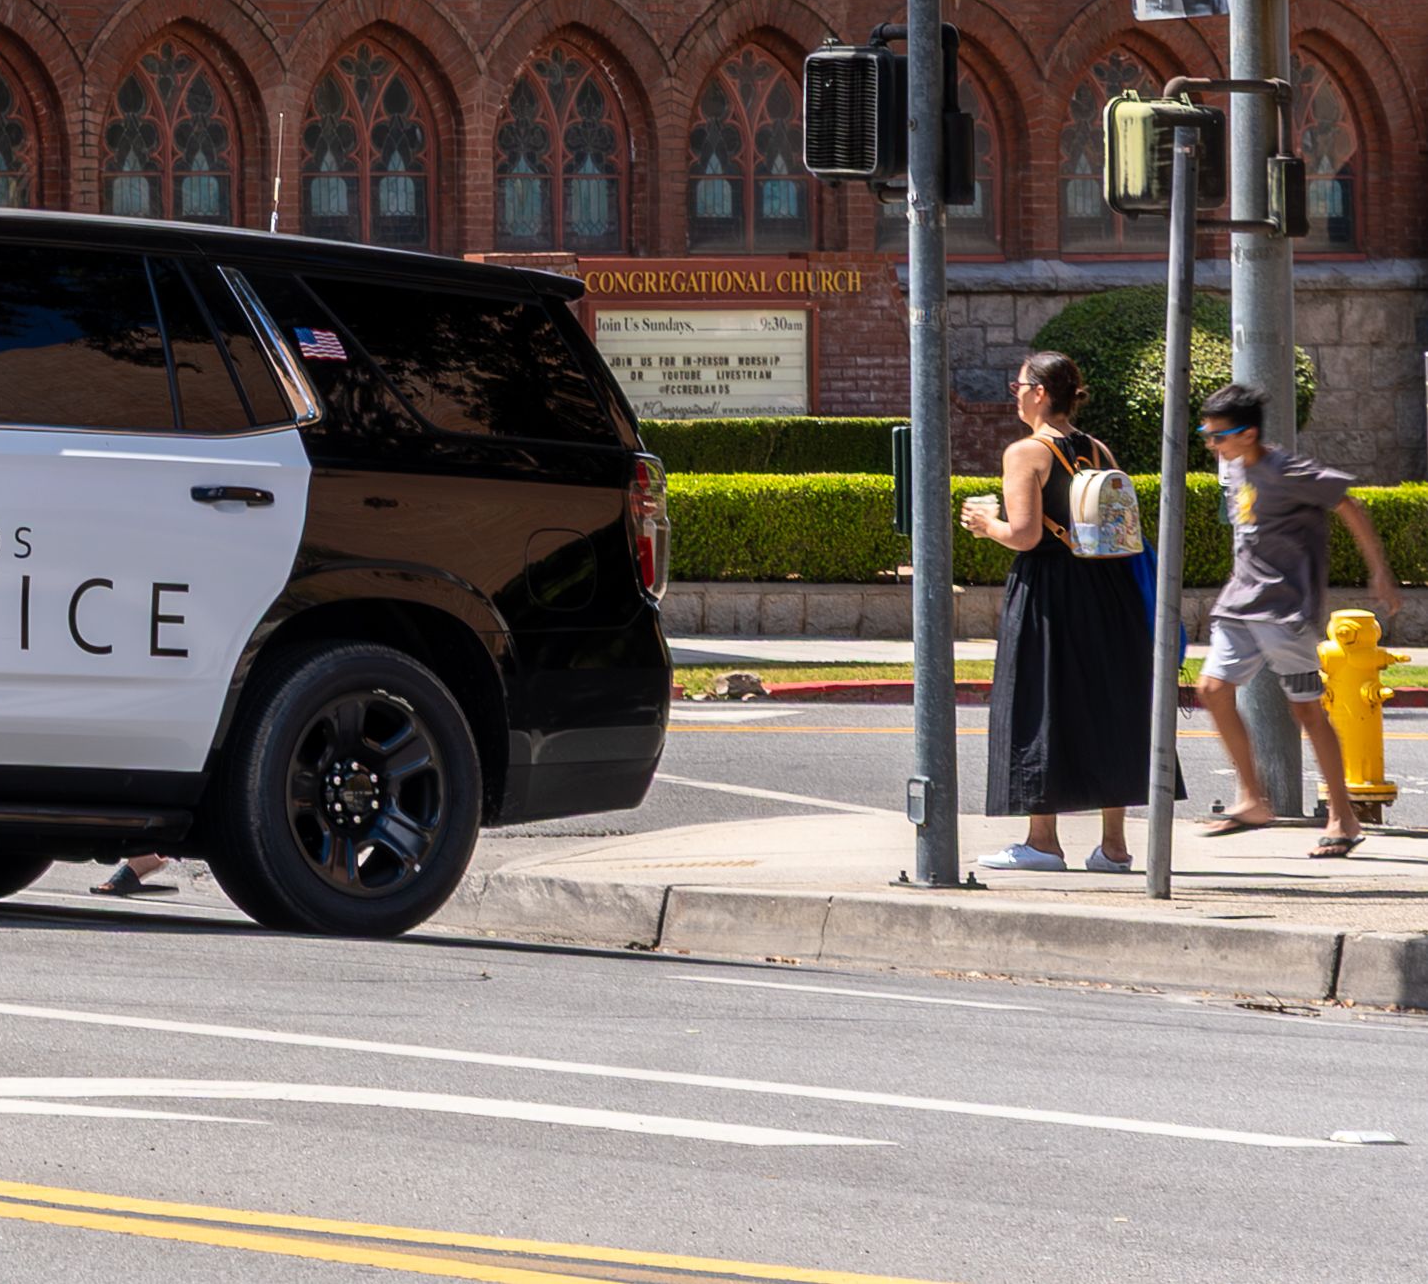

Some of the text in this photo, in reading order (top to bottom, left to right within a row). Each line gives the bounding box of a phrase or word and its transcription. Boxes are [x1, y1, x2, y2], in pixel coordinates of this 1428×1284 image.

[585, 270, 773, 294] CONGREGATIONAL
[776, 270, 863, 294] CHURCH
[596, 316, 803, 335] Join Us Sundays, 9:30am
[641, 356, 652, 367] US
[659, 356, 675, 367] FOR
[683, 356, 729, 367] IN-PERSON
[630, 370, 773, 382] OR YOUTUBE LIVESTREAM
